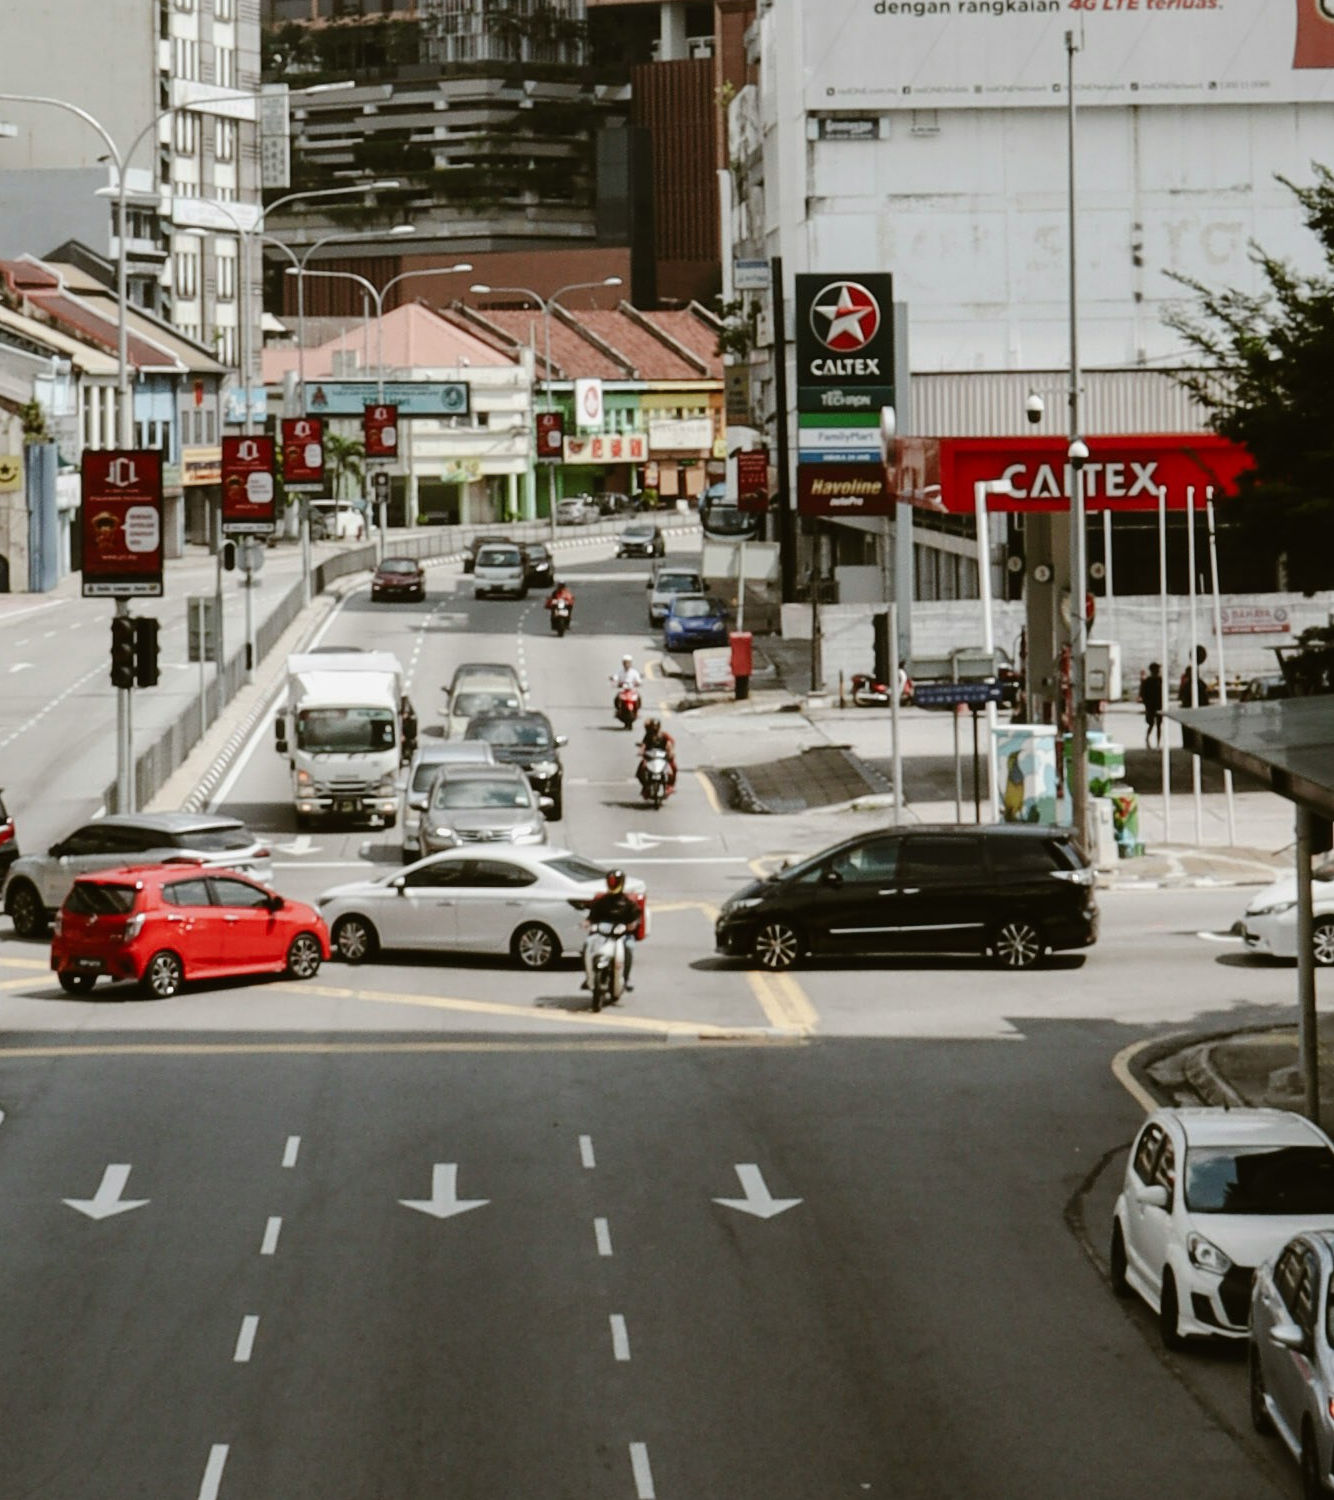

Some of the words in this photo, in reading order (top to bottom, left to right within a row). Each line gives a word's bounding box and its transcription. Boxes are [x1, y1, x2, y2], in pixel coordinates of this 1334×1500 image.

[874, 0, 951, 17] dengan
[810, 358, 880, 376] CALTEX
[817, 431, 875, 443] FamilyMart
[811, 478, 882, 496] Havoline
